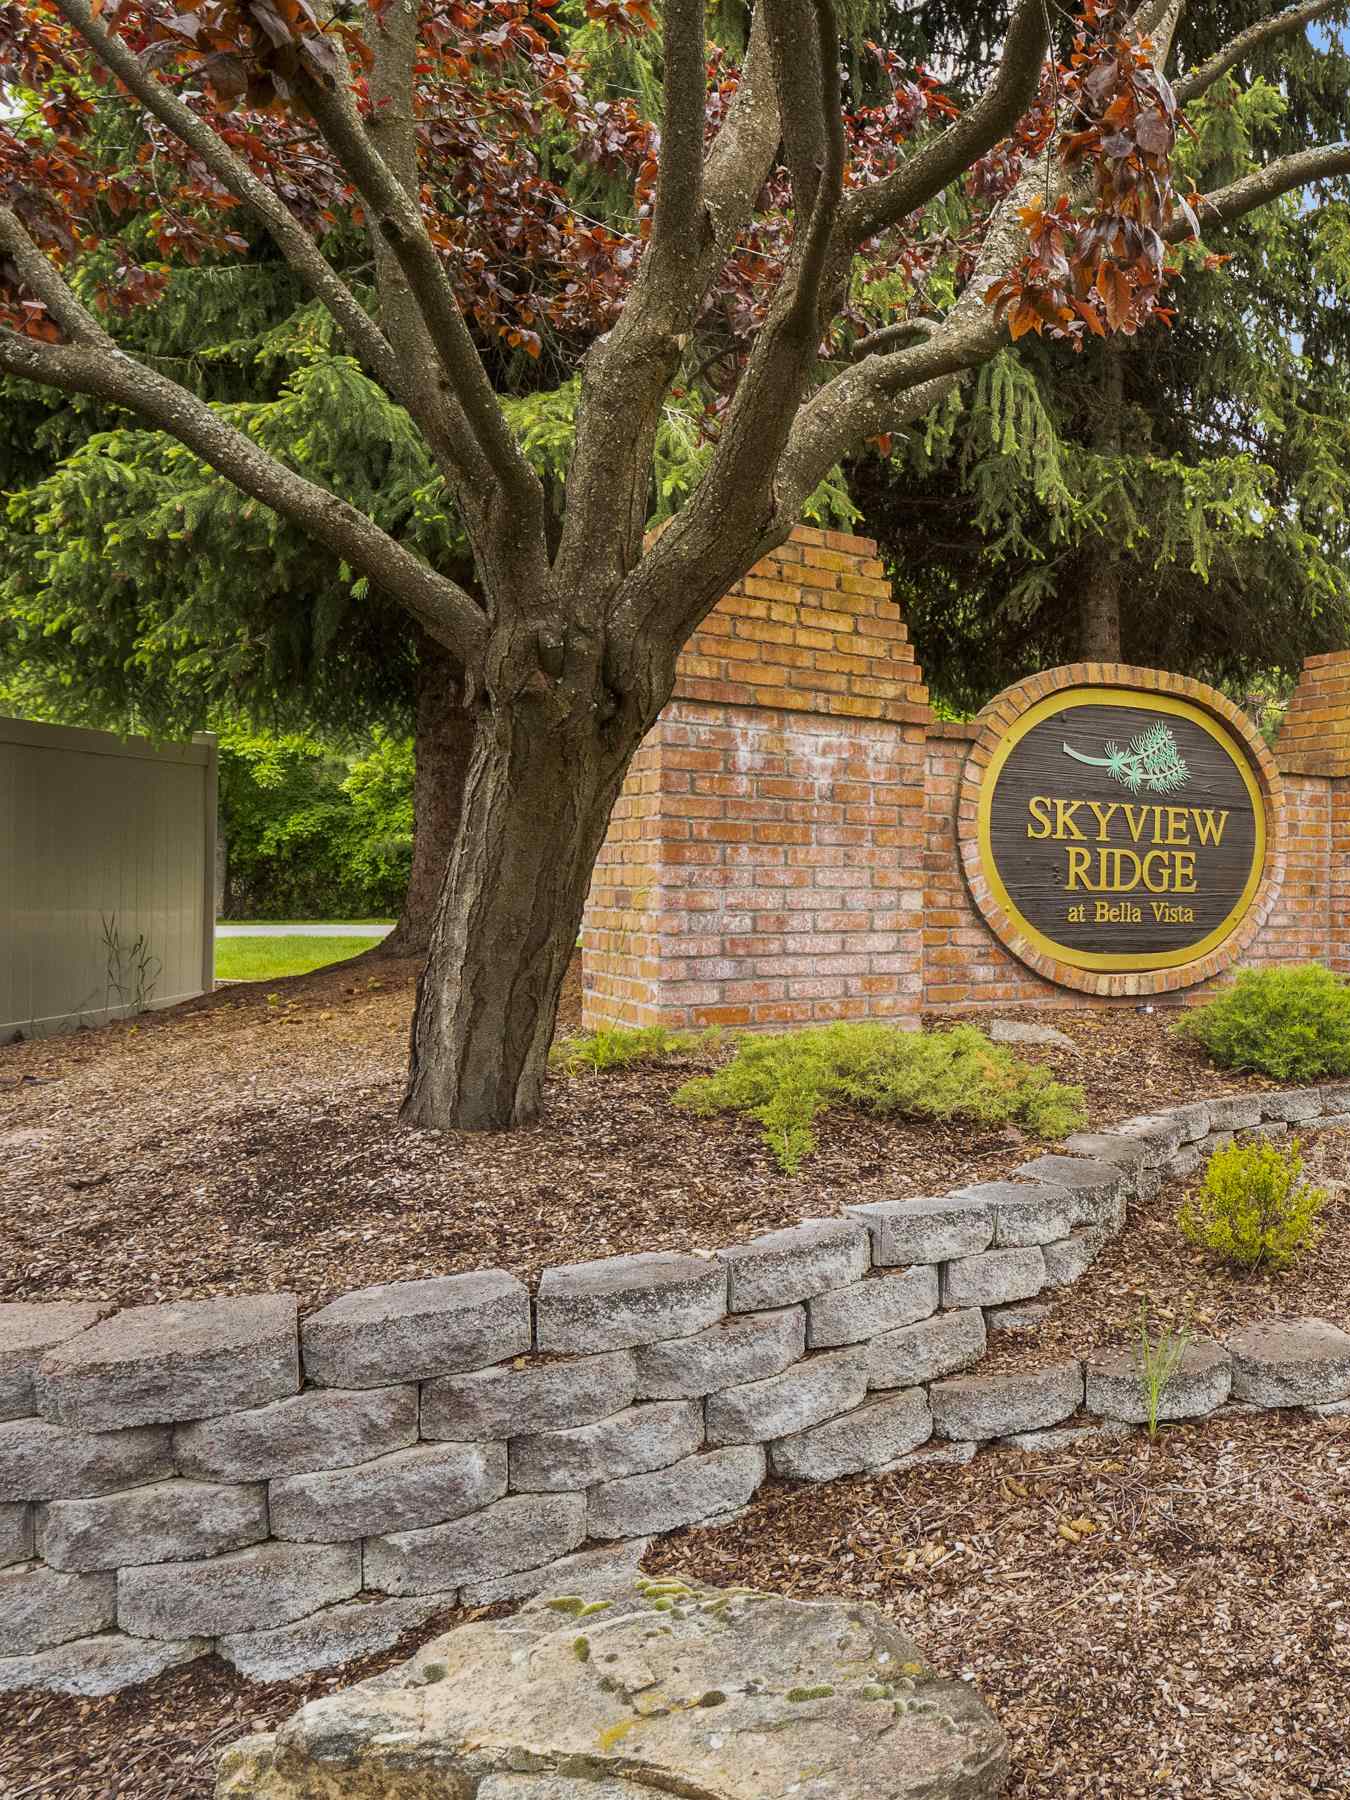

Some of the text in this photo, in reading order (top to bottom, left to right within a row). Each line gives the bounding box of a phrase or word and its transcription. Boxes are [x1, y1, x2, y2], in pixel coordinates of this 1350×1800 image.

[1027, 796, 1229, 846] SKYVIEW
[1064, 847, 1197, 893] RIDGE
[1067, 901, 1195, 922] at Bella Vista
